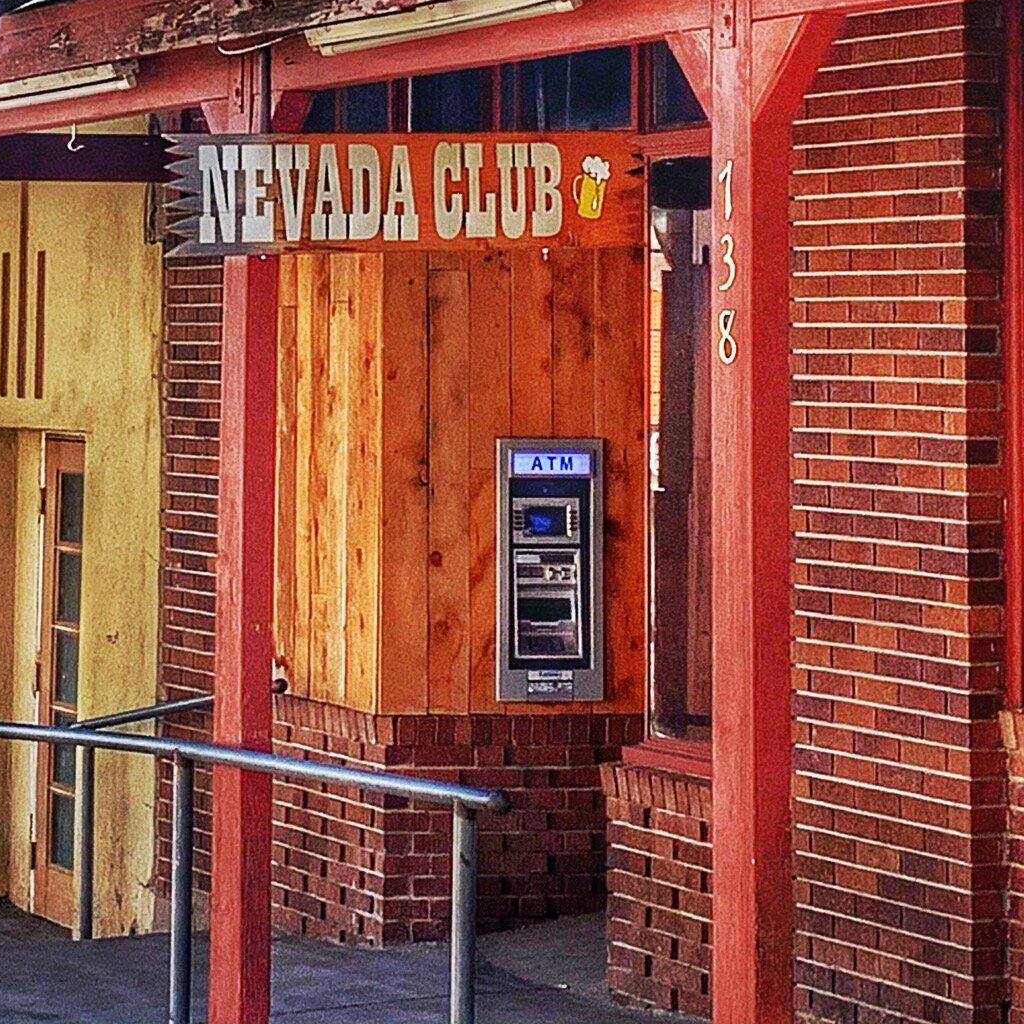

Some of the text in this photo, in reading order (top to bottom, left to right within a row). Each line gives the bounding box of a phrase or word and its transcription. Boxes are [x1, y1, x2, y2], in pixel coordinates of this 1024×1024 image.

[198, 140, 563, 244] NEVADA CLUB
[718, 160, 737, 365] 138
[531, 456, 574, 471] ATM
